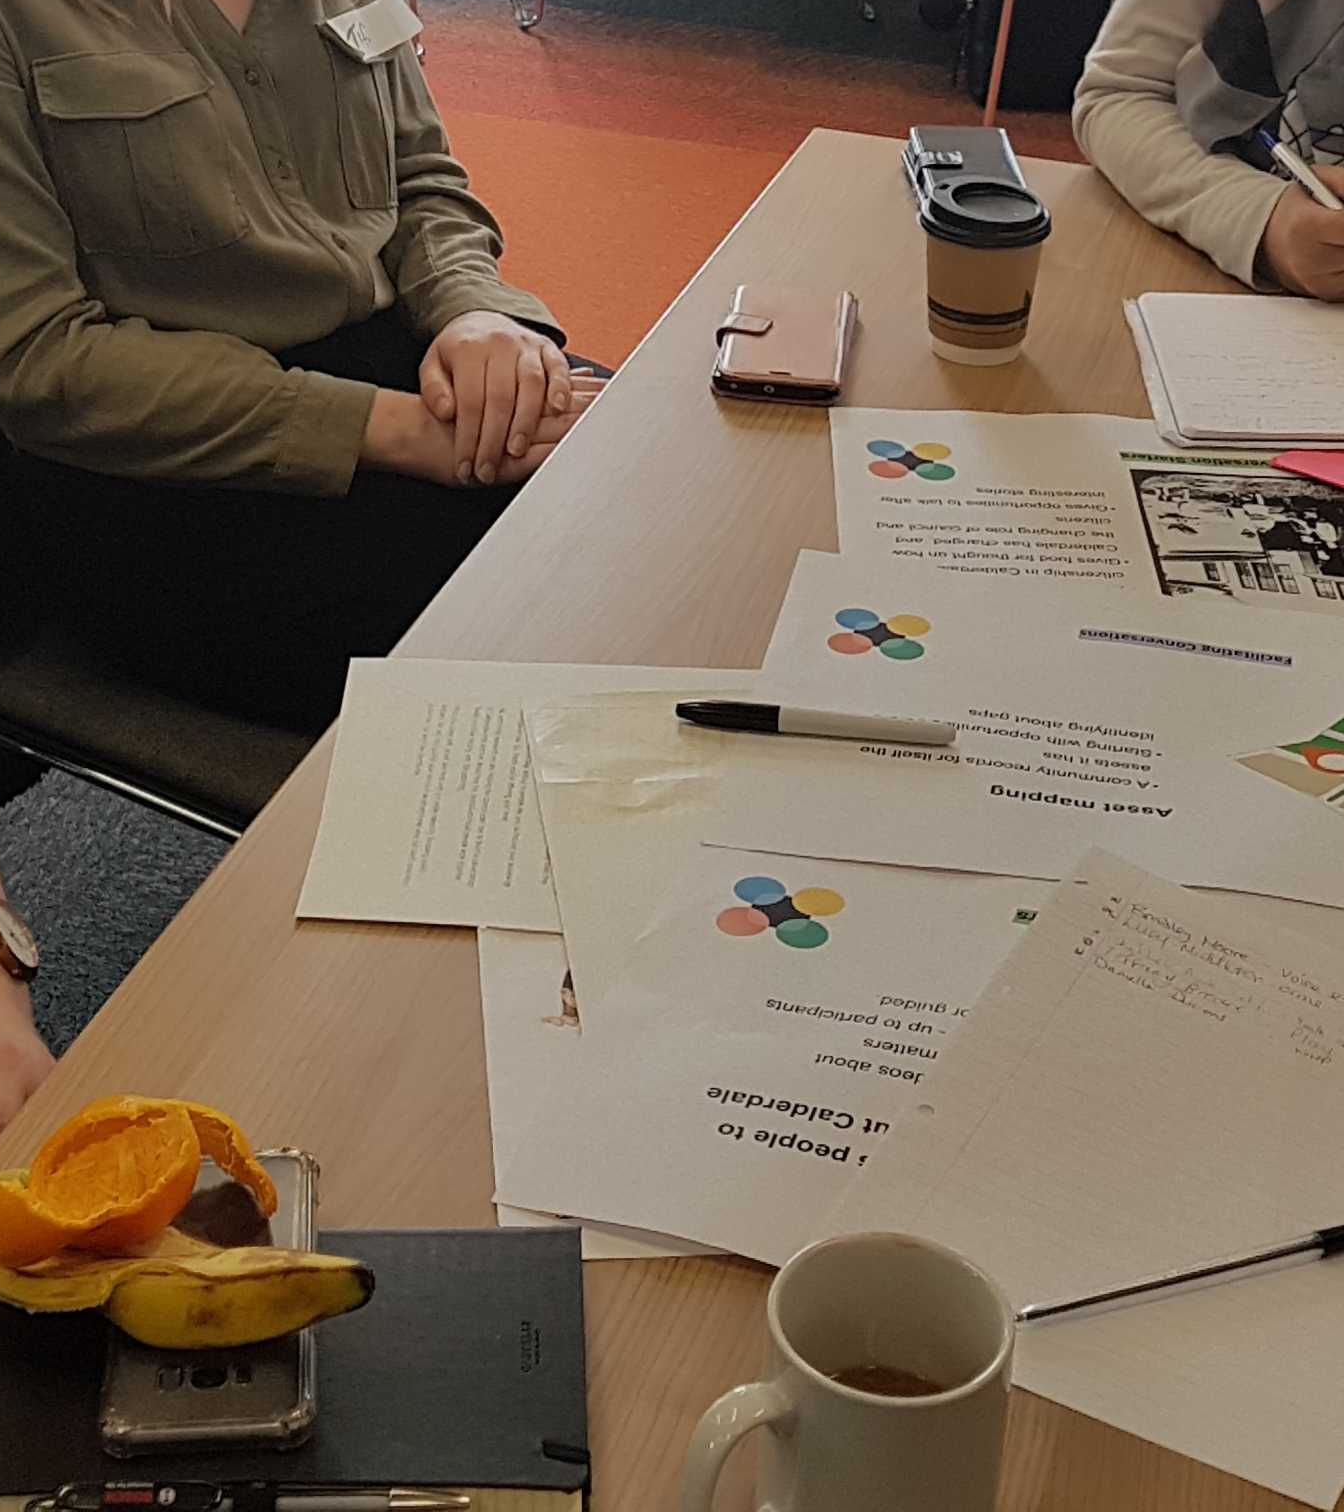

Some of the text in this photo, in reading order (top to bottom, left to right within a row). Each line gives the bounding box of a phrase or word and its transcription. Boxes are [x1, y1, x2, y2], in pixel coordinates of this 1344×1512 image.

[1119, 453, 1189, 465] Starters
[975, 487, 1106, 499] interesting stories
[880, 496, 912, 505] after
[917, 497, 944, 506] talk
[966, 498, 1061, 509] opportunities
[1065, 502, 1108, 512] Gives
[876, 521, 904, 530] and
[1055, 515, 1112, 526] citizens
[908, 523, 962, 532] council
[984, 526, 1013, 534] role
[1017, 525, 1086, 538] changing
[896, 536, 924, 545] and
[1091, 531, 1115, 539] the
[1003, 540, 1031, 548] has
[1036, 542, 1118, 553] Calderdale
[892, 550, 923, 558] how
[952, 550, 1010, 561] thought
[1015, 554, 1035, 563] for
[1040, 555, 1073, 564] food
[1077, 557, 1121, 566] Gives
[1043, 567, 1125, 580] citizenship
[1079, 630, 1293, 666] Facilitating Conversations
[969, 708, 1155, 743] identifying about gaps
[1047, 736, 1082, 750] with
[1086, 740, 1152, 759] Starting
[859, 745, 1150, 789] A community records for itself the
[1042, 751, 1152, 774] assets it has
[989, 784, 1174, 819] Asset mapping
[765, 998, 933, 1036] up to participants
[862, 1037, 938, 1062] matters
[814, 1053, 873, 1073] about
[705, 1087, 856, 1130] Calderdale
[717, 1122, 746, 1142] to
[753, 1129, 851, 1163] people
